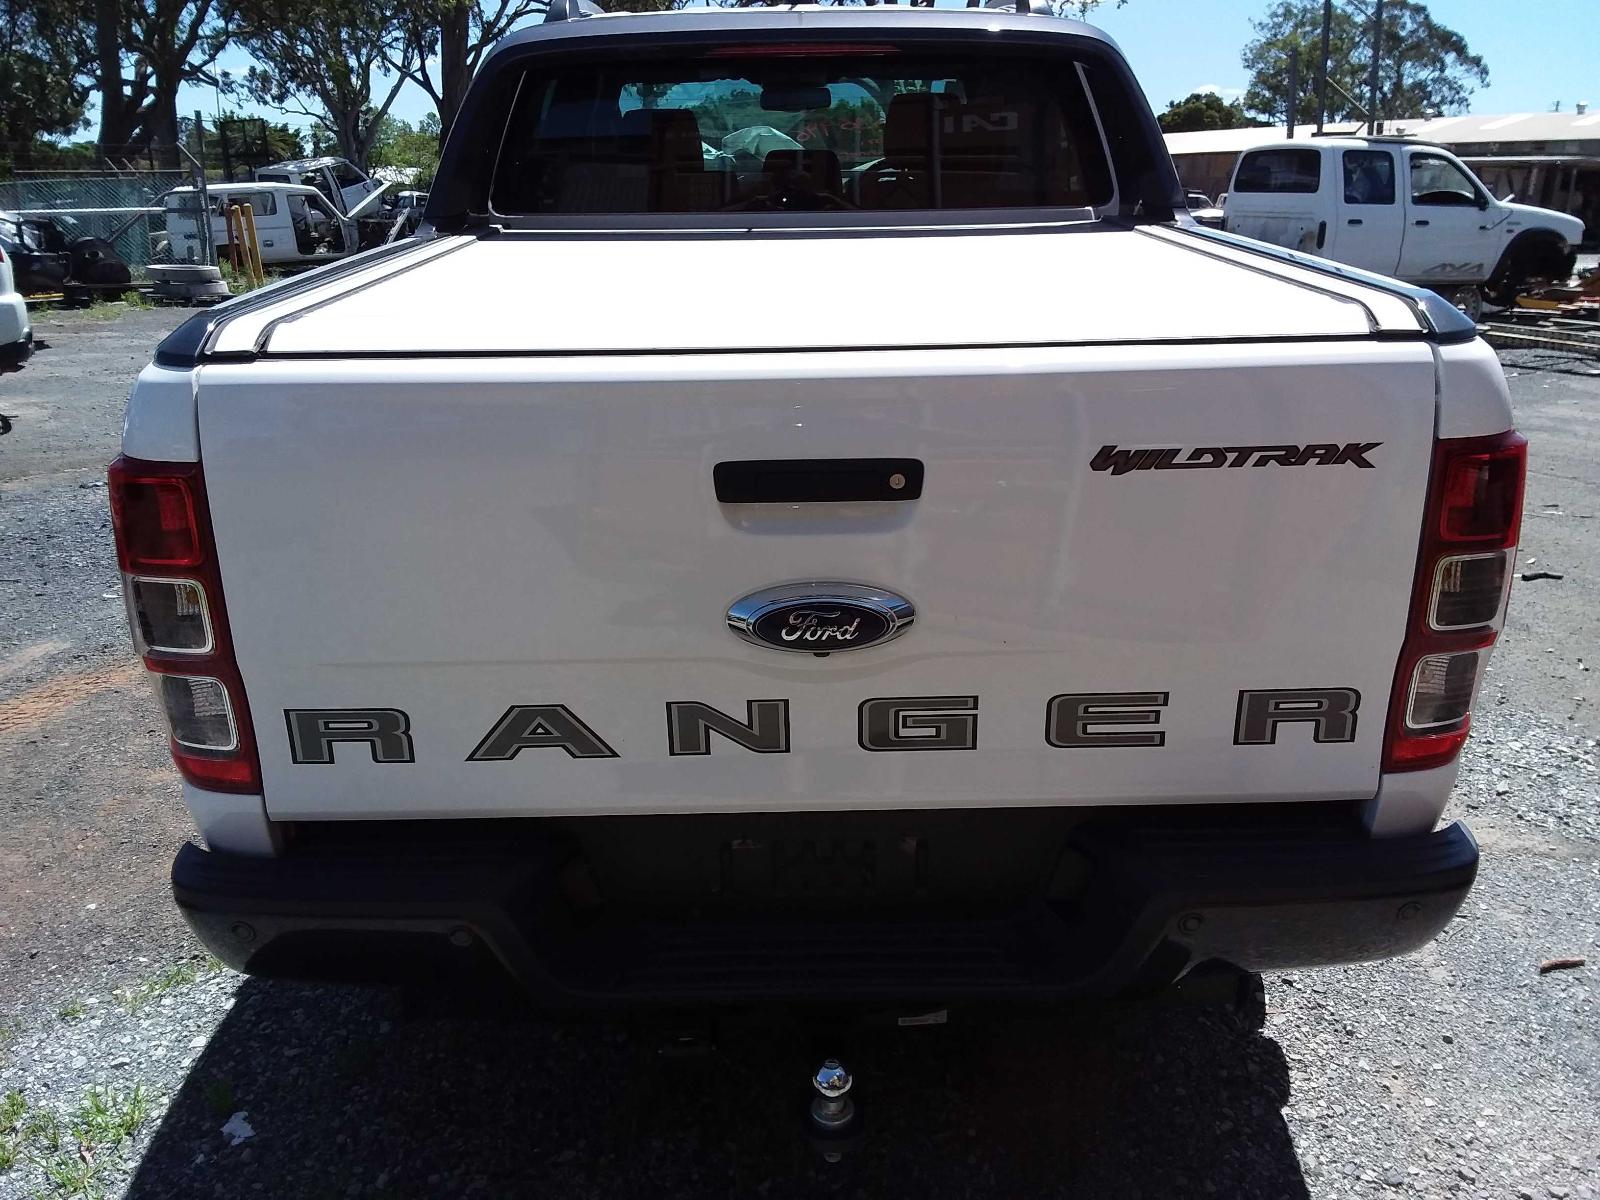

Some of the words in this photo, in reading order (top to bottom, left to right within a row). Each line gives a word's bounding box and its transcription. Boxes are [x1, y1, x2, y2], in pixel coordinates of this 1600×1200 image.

[1090, 442, 1384, 475] WILDTRAK
[781, 610, 861, 641] Ford
[283, 687, 1361, 764] RANGER
